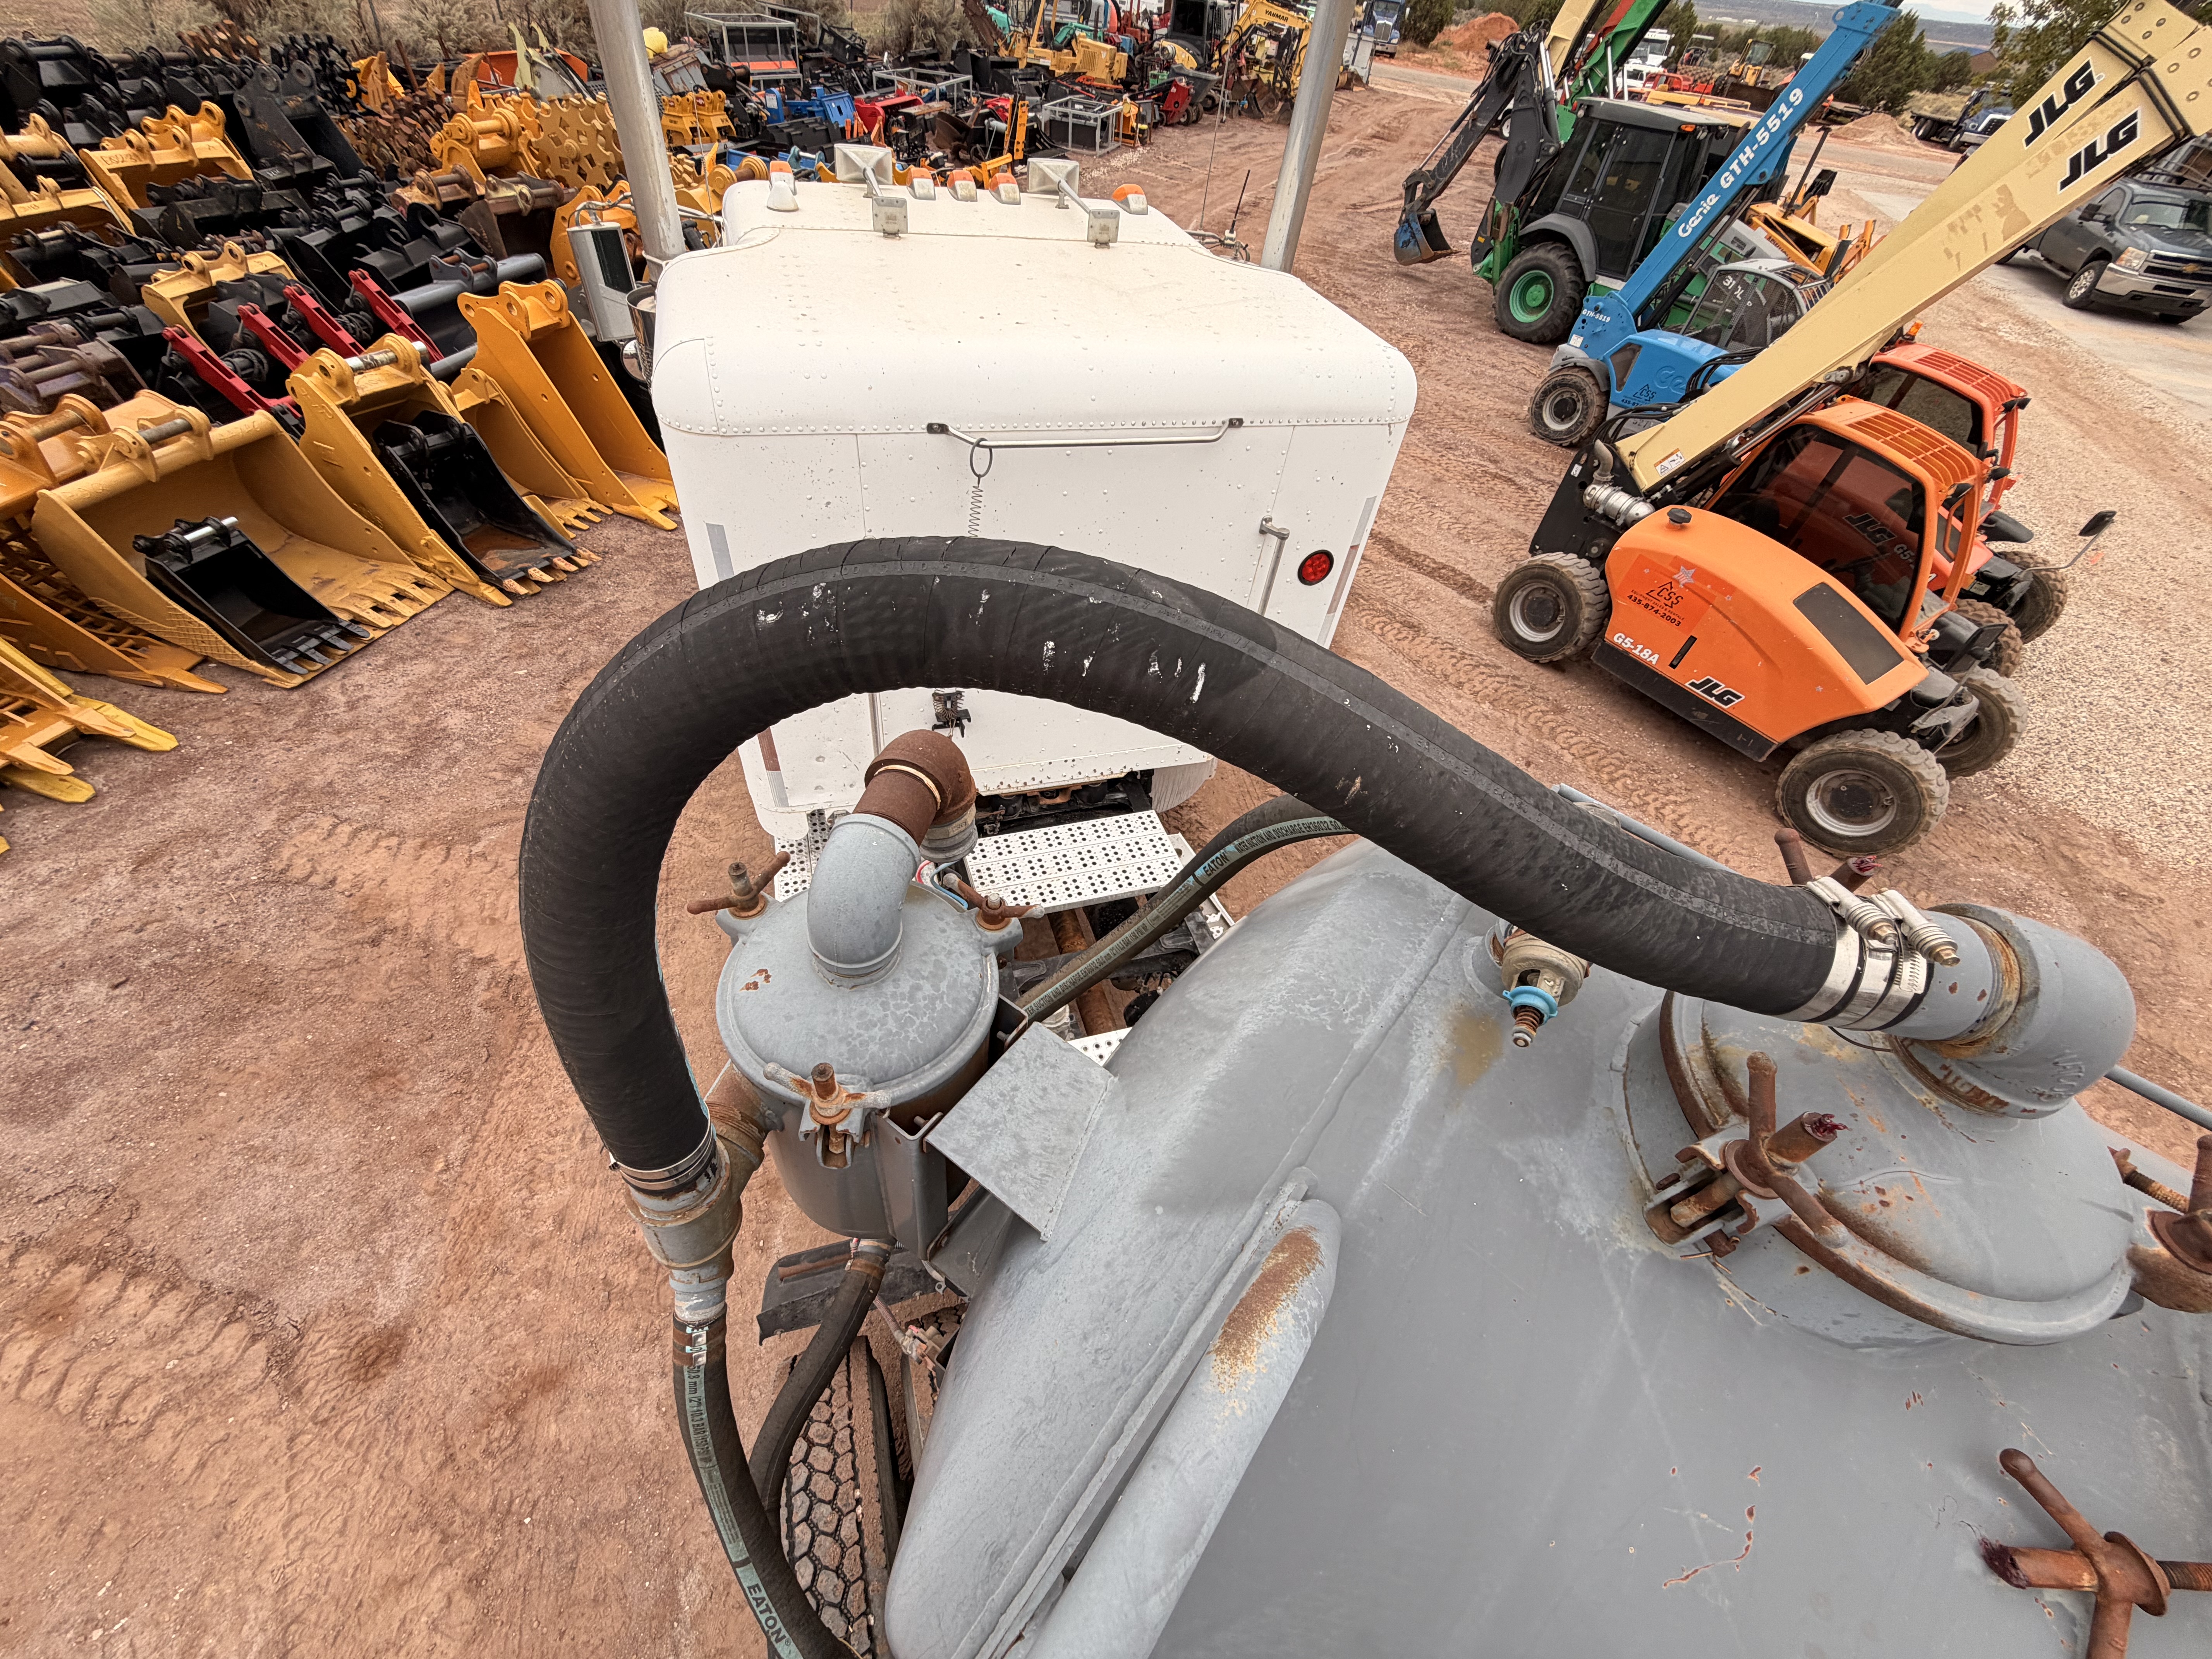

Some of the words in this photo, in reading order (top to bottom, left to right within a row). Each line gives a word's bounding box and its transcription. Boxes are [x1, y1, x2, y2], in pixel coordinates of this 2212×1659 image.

[1265, 9, 1289, 22] YANMAR
[2023, 57, 2097, 149] JLG
[1678, 194, 1720, 238] Genie
[1720, 88, 1803, 189] GTH-5519
[2058, 108, 2140, 193] JLG
[1582, 309, 1611, 323] GTH-5519
[1639, 388, 1657, 399] CSS
[1843, 513, 1897, 545] JLG
[1627, 594, 1681, 627] 435-874-2003
[1657, 587, 1684, 605] CSS
[1613, 632, 1660, 665] G5-18A
[1685, 676, 1744, 708] JLG
[1234, 840, 1249, 854] WATER
[1245, 832, 1267, 848] SUCTION
[1265, 830, 1276, 842] AND
[1272, 823, 1305, 838] DISCHARGE
[1302, 820, 1332, 833] EH36032
[1033, 992, 1054, 1010] SUCTION
[1052, 987, 1062, 998] AND
[1059, 972, 1084, 992] DISCHARGE
[688, 1381, 697, 1395] mm
[692, 1422, 706, 1435] BAR
